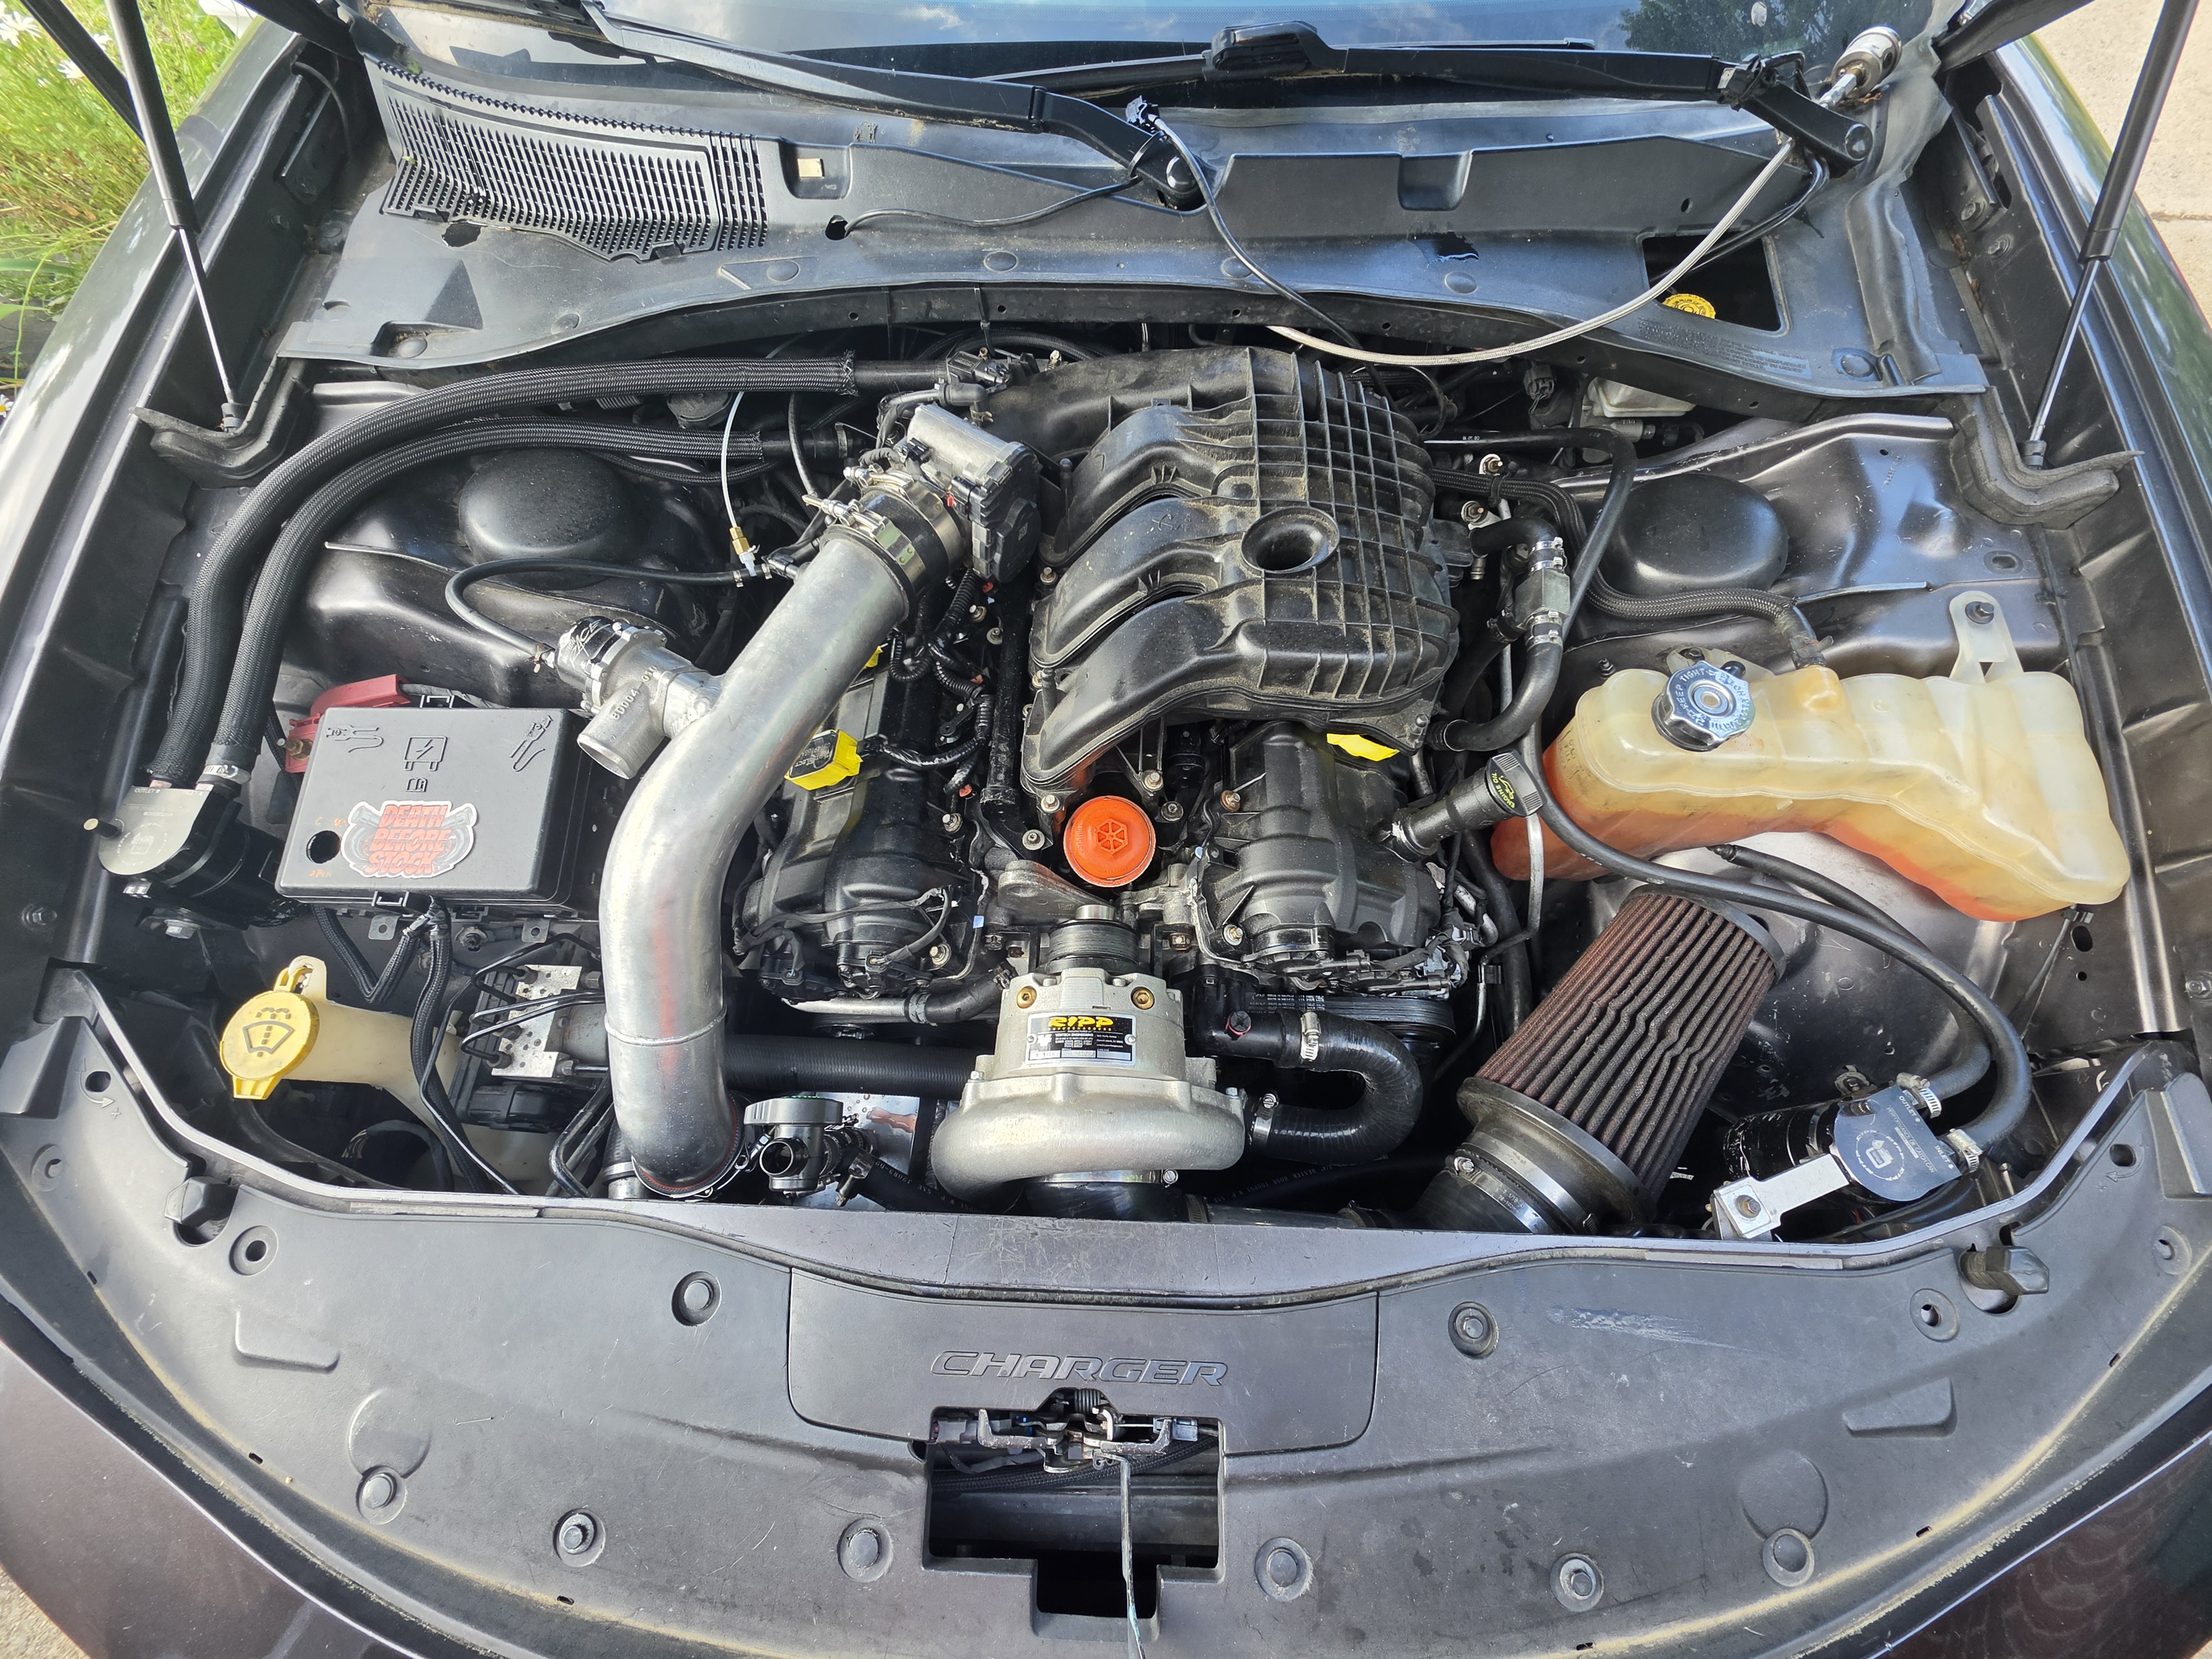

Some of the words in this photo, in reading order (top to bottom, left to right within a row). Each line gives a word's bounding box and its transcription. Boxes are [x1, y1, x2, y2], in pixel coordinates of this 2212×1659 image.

[569, 619, 603, 670] RACE
[1679, 667, 1705, 682] TIGHT
[1675, 684, 1688, 709] KEEP
[1495, 785, 1515, 808] ENGINE
[378, 804, 449, 828] DEATH
[369, 828, 453, 852] BEFORE
[364, 851, 439, 875] STOCK
[1048, 1016, 1114, 1027] RIPP
[1898, 1095, 1917, 1118] OUTLET
[1885, 1105, 1911, 1141] PERFORMANCE
[1934, 1145, 1950, 1162] INLET
[875, 1161, 912, 1185] J20R3-D2
[1273, 1176, 1289, 1185] HOSE
[1292, 1168, 1317, 1179] HEATER
[917, 1185, 932, 1194] SAE
[930, 1350, 1229, 1387] CHARGER
